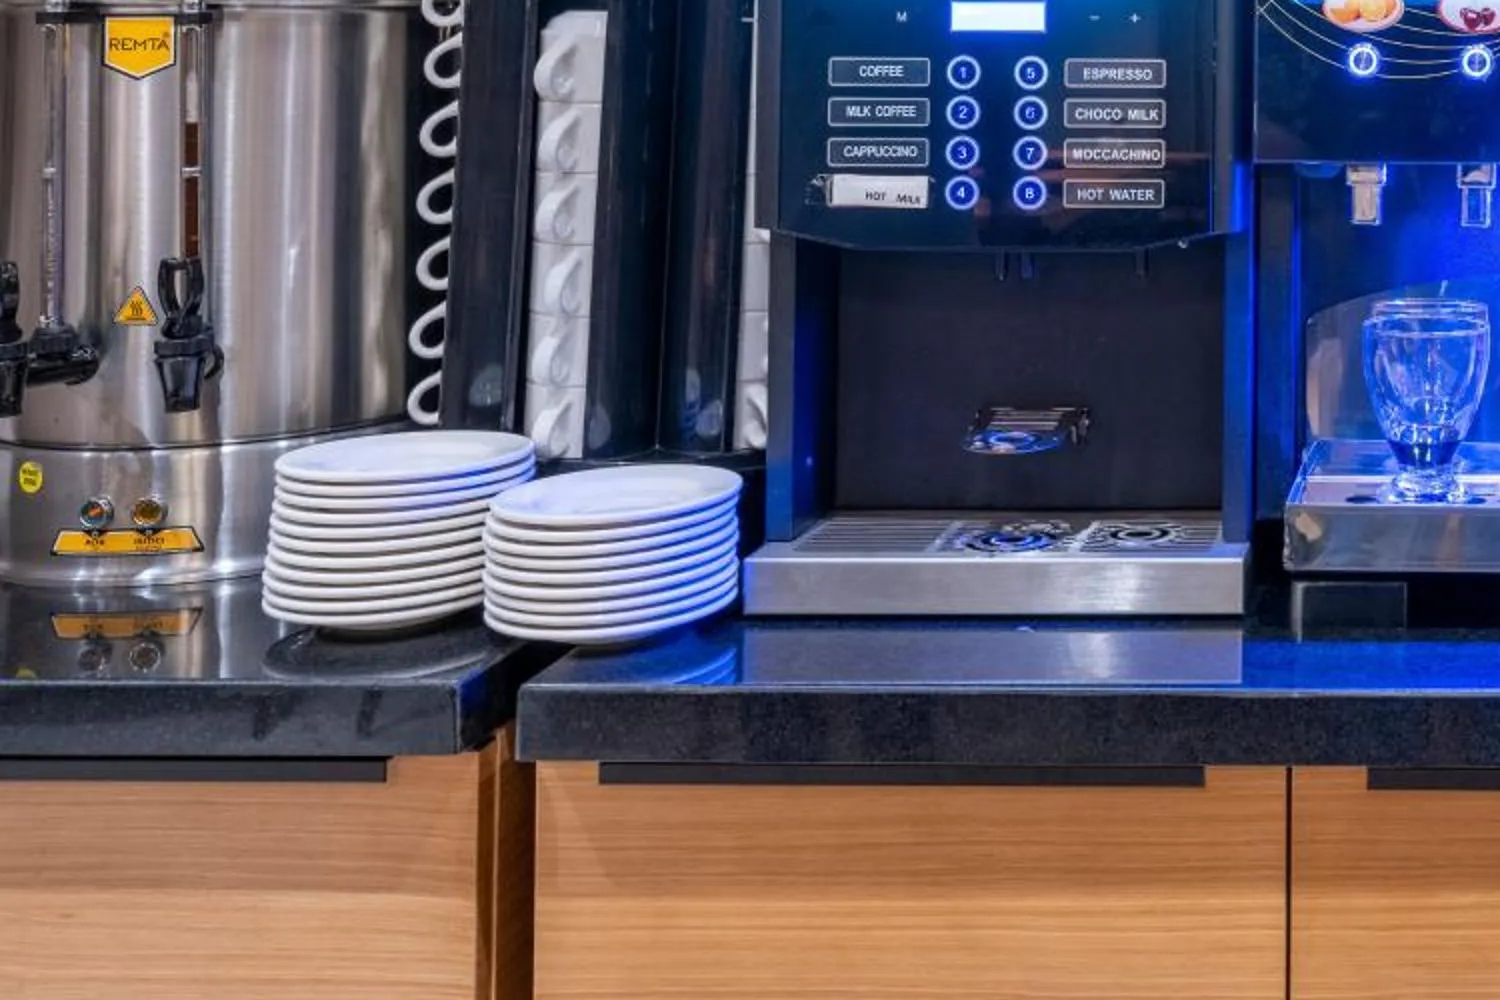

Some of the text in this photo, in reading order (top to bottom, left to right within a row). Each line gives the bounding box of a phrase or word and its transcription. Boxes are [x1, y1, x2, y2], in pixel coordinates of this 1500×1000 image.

[896, 11, 908, 23] M
[109, 36, 170, 52] REMTA
[859, 65, 905, 77] COFFEE
[1026, 67, 1036, 80] 5
[1083, 67, 1153, 81] ESPRESSO
[846, 105, 917, 118] MILK COFFEE
[958, 105, 968, 119] 2
[1025, 106, 1035, 120] 6
[1074, 108, 1160, 121] CHOCO MILK
[843, 145, 918, 158] CAPPUCCINO
[958, 146, 967, 160] 3
[1025, 147, 1035, 160] 7
[1073, 147, 1161, 161] MOCCACHINO
[865, 191, 886, 201] HOT
[956, 186, 966, 199] 4
[1024, 186, 1035, 199] 8
[1077, 188, 1155, 201] HOT WATER
